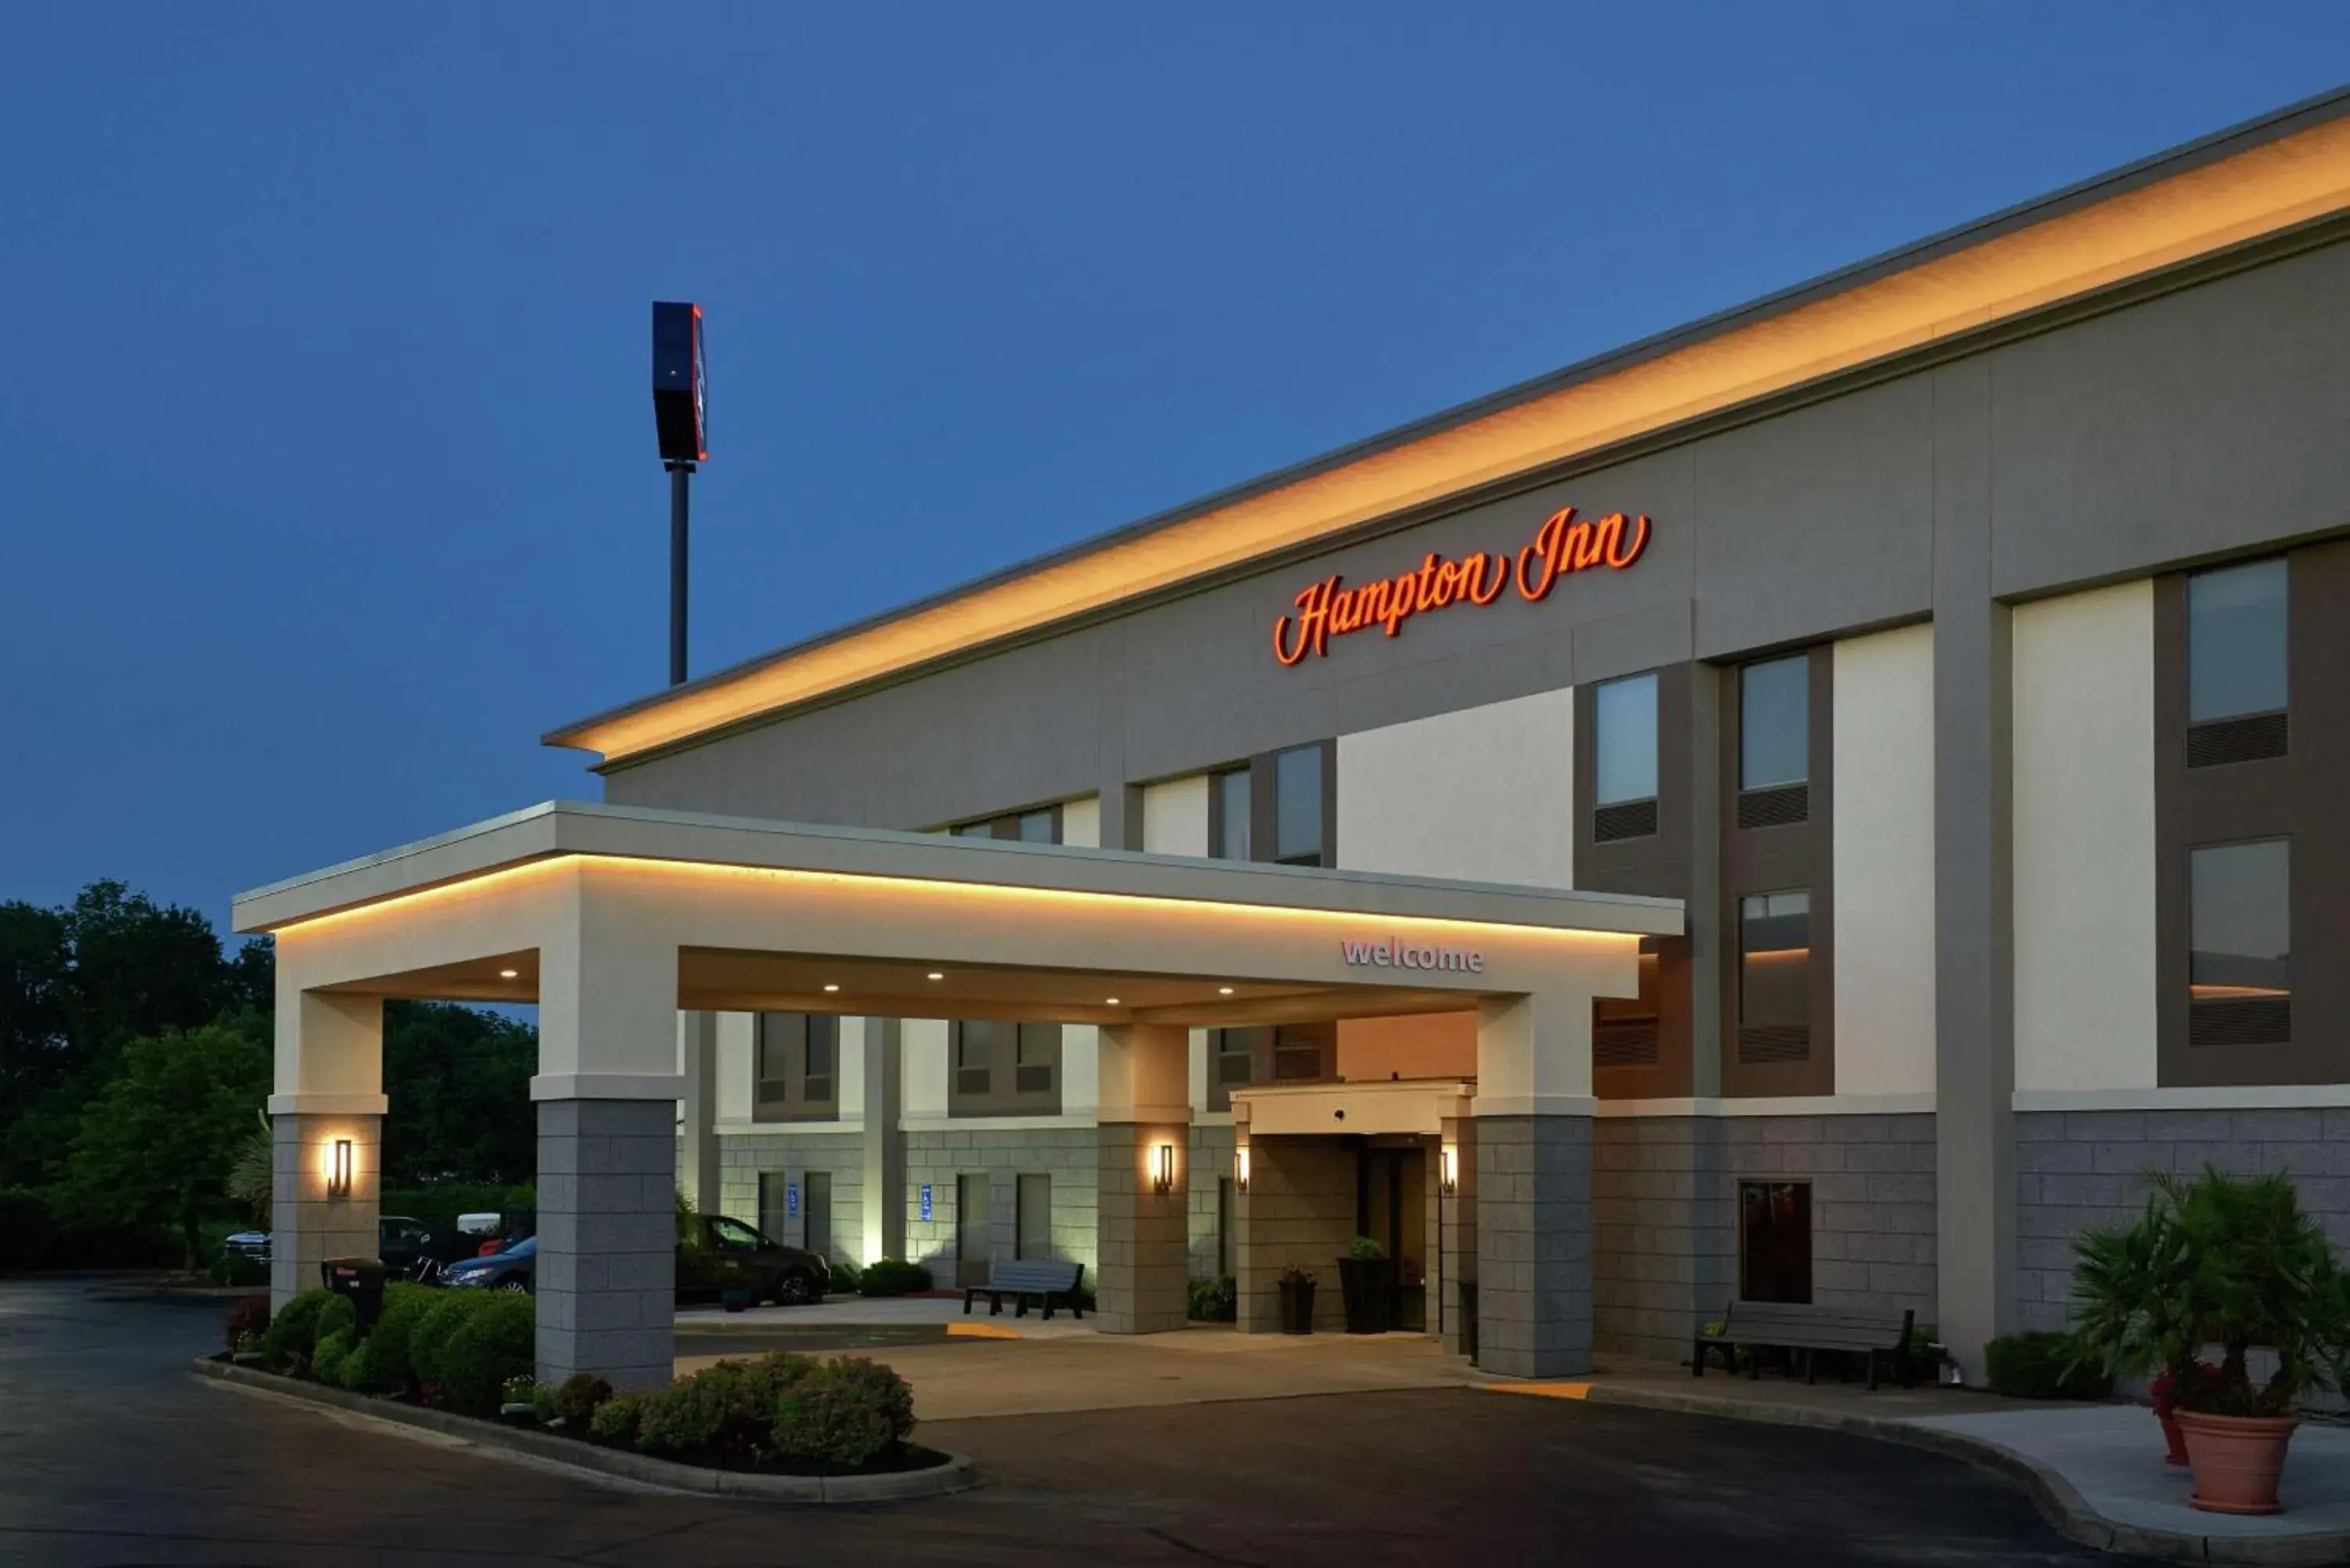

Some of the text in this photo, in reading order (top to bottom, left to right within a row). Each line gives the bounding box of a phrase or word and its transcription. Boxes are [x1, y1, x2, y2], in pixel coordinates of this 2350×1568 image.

[1275, 507, 1651, 666] Hampton Inn
[1342, 936, 1484, 973] welcome
